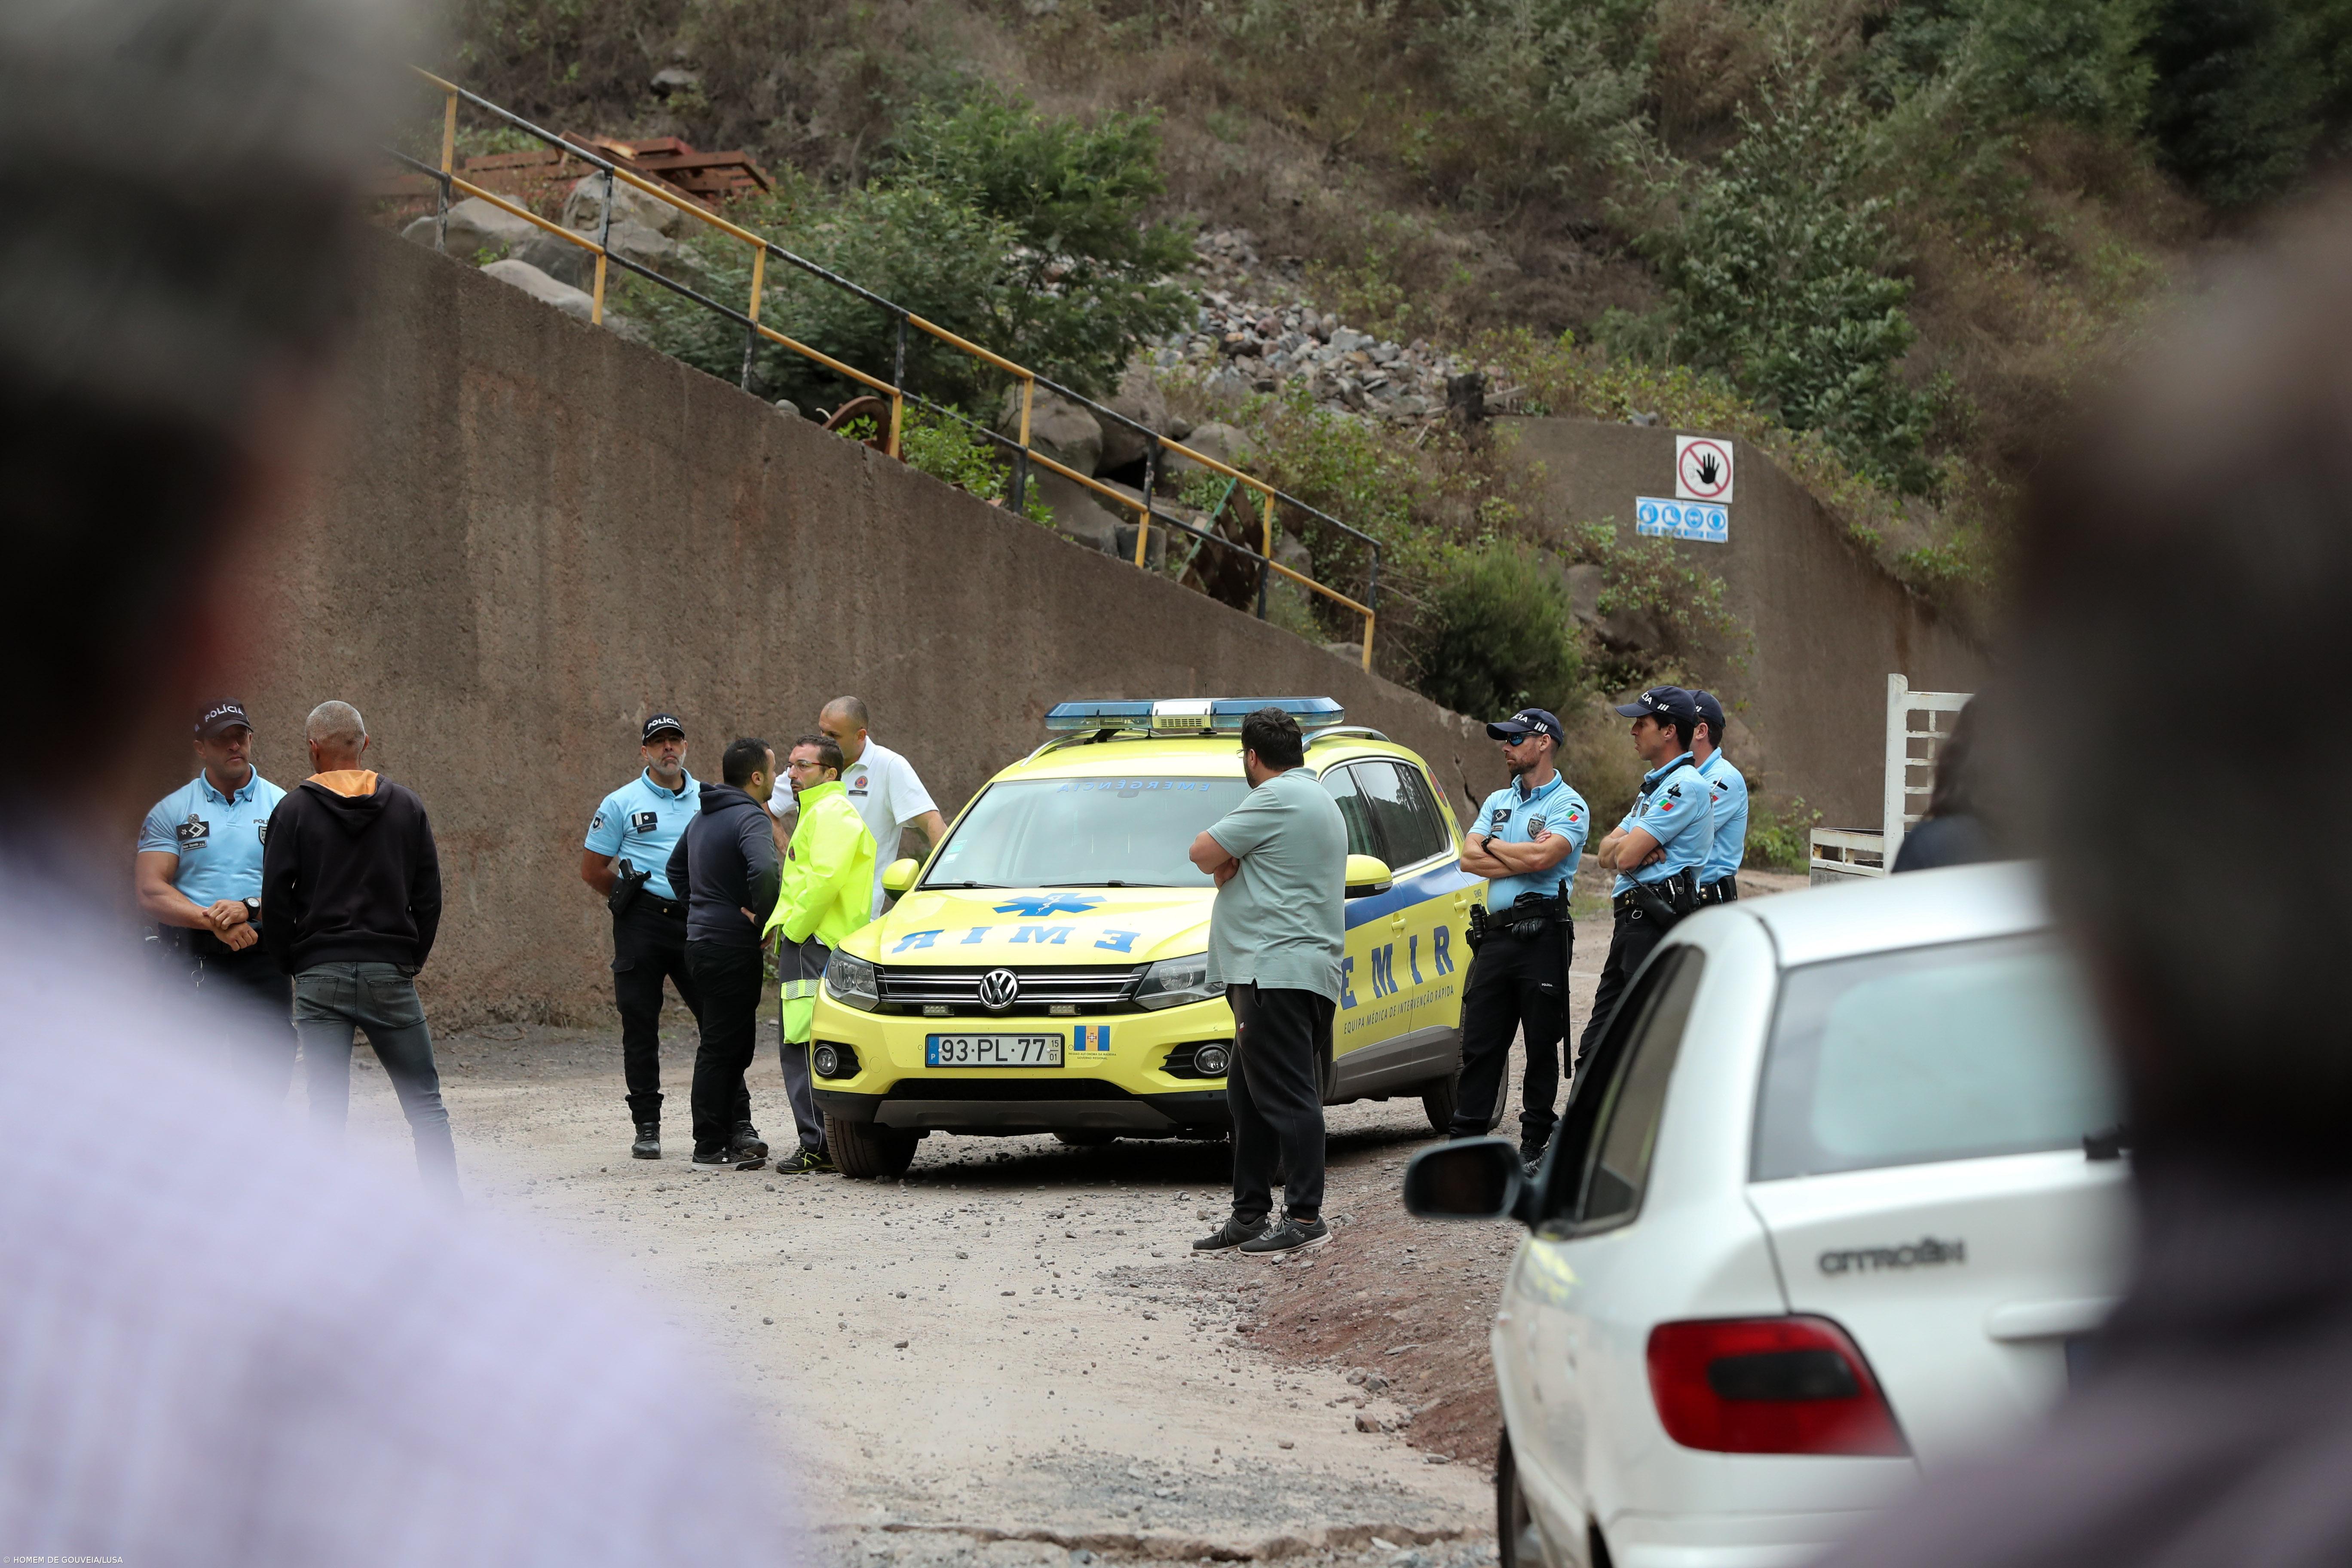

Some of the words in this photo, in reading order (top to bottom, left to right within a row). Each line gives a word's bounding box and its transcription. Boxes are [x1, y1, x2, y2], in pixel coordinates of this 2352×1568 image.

[205, 704, 244, 723] POLÍCIA
[648, 717, 680, 730] POLÍCIA
[1340, 925, 1455, 1011] EMIR
[1344, 1017, 1365, 1035] EQUIPA
[1366, 1008, 1388, 1026] MÉDICA
[1389, 1005, 1396, 1018] DE
[1397, 990, 1433, 1015] INTERVENÇÃO
[1435, 984, 1454, 1001] RÁPIDA
[1291, 1228, 1305, 1238] FILA
